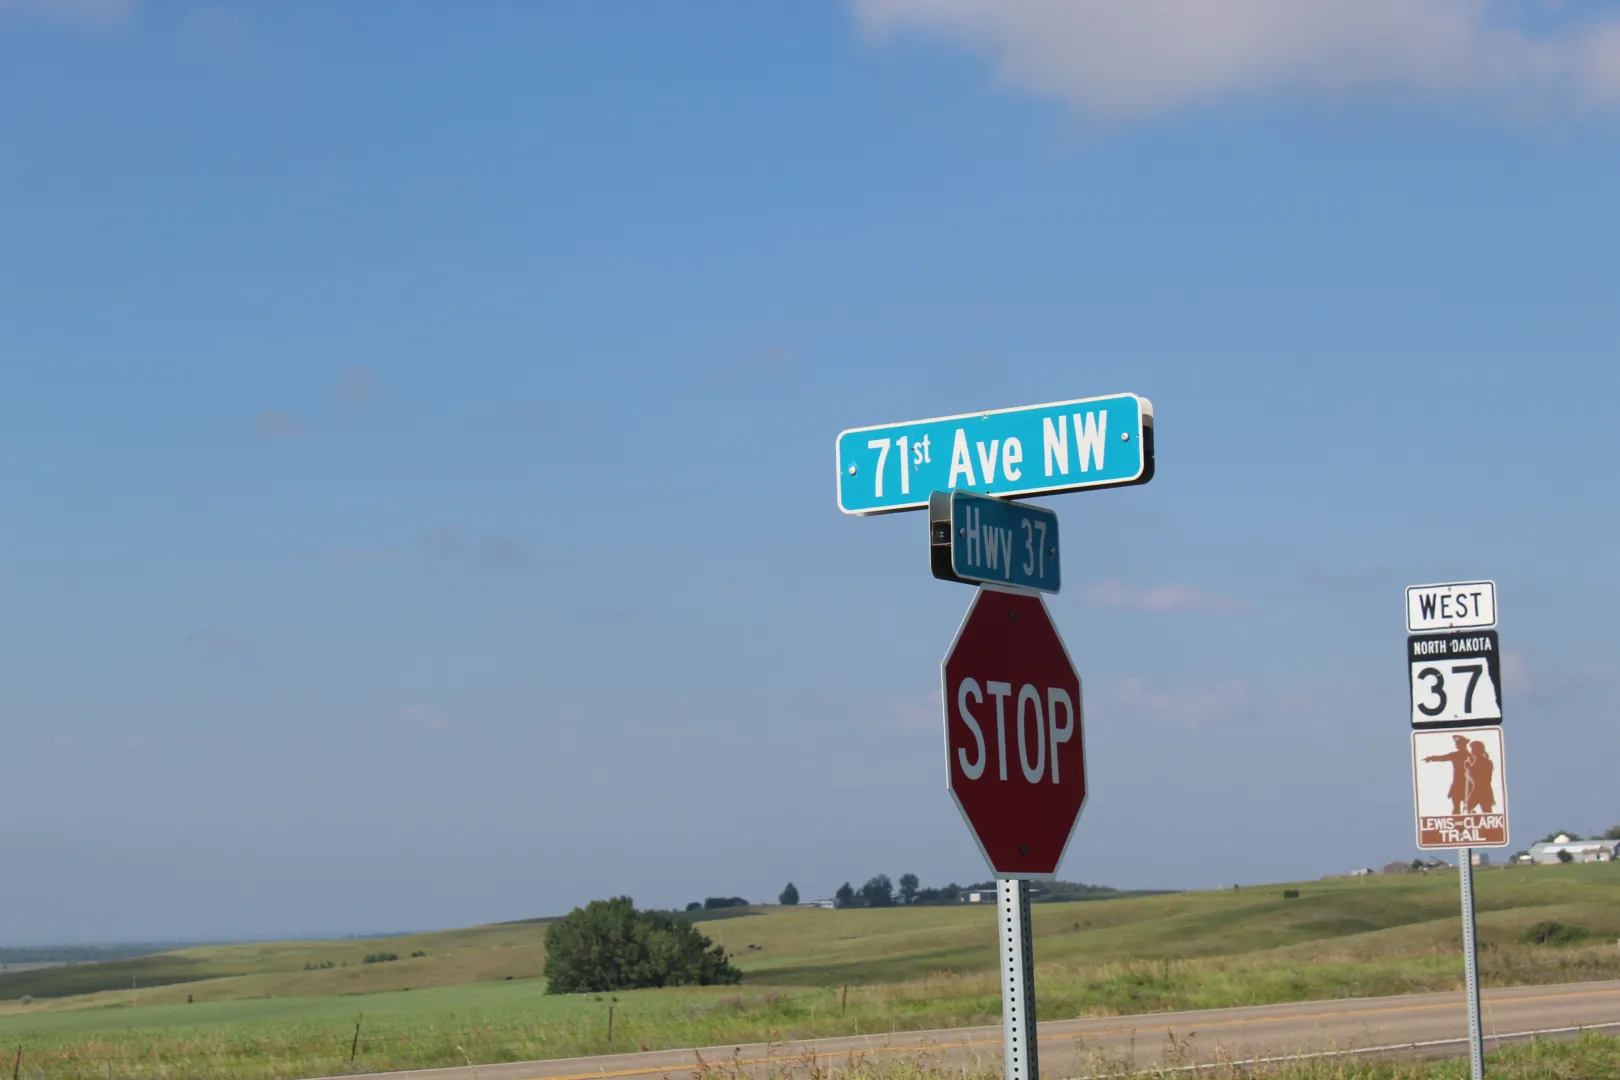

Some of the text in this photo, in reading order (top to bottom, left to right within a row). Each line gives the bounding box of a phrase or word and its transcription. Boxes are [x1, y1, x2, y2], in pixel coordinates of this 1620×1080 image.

[867, 409, 1108, 498] 71st Ave NW
[966, 505, 1047, 579] Hwy 37
[1419, 592, 1482, 621] WEST
[1413, 636, 1492, 656] NORTH DAKOTA
[1417, 664, 1483, 716] 37
[957, 677, 1074, 785] STOP
[1420, 817, 1455, 831] LEWIS
[1463, 815, 1504, 830] CLARK
[1439, 827, 1487, 843] TRAIL
